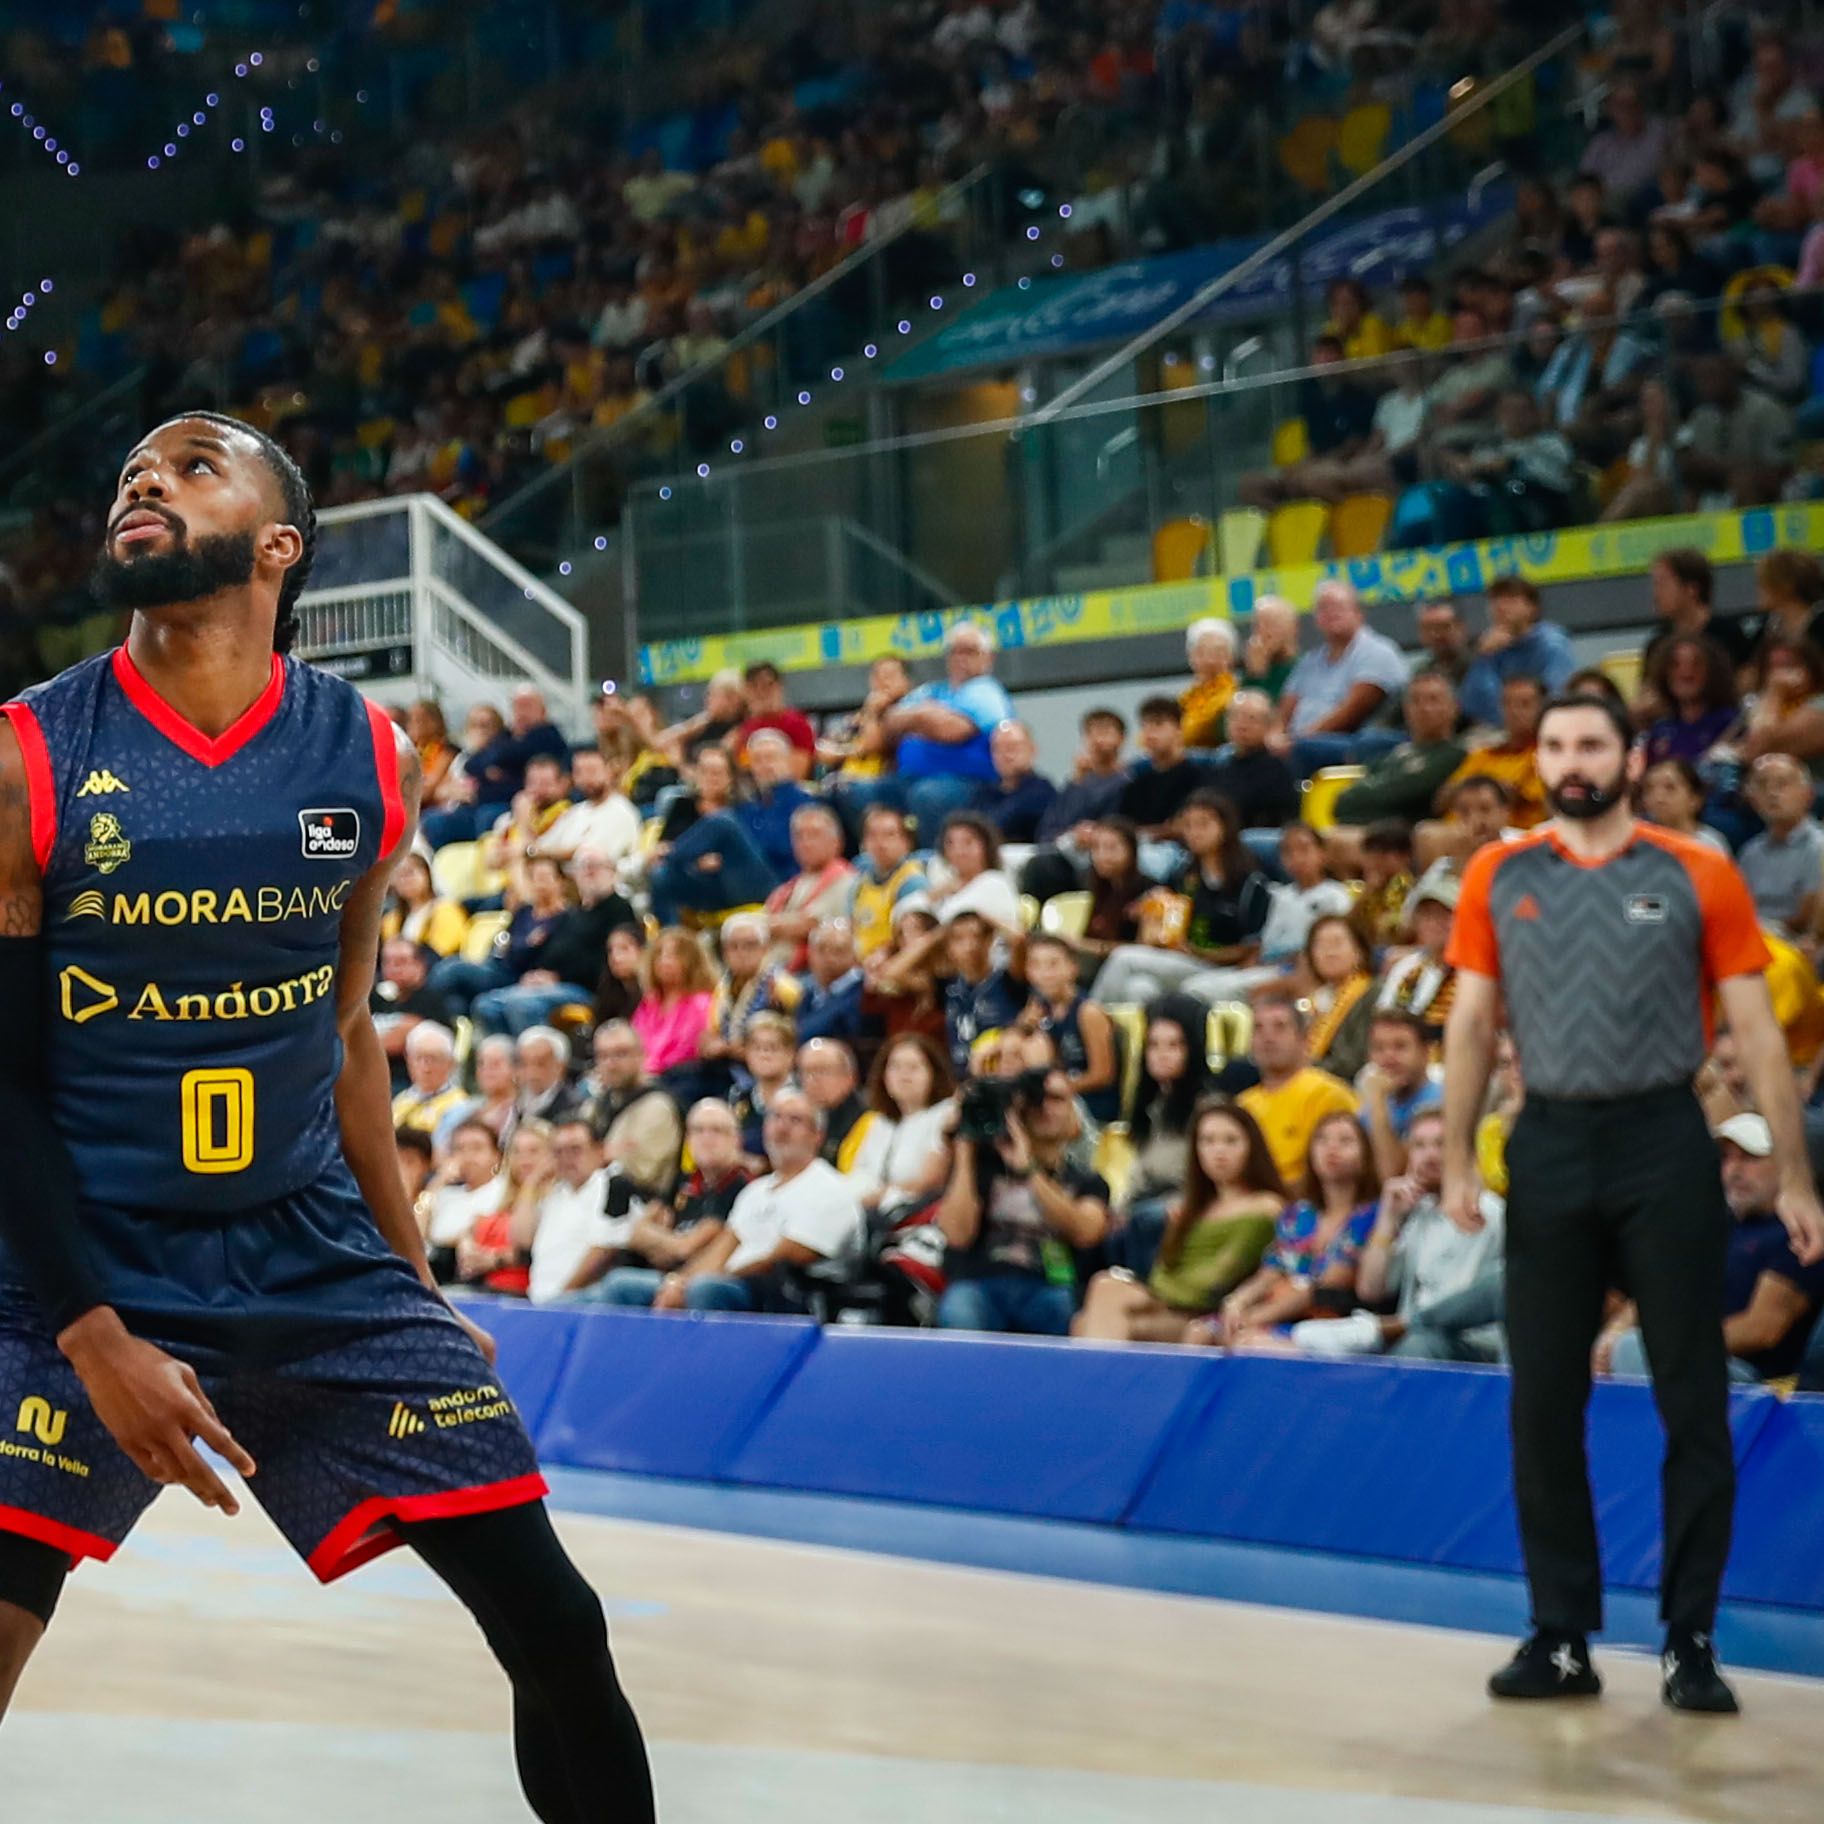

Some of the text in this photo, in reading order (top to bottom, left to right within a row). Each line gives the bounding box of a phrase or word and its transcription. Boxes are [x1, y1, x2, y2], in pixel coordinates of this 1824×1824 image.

[308, 823, 332, 841] liga
[112, 880, 350, 925] MORABANC
[127, 964, 334, 1022] Andorra
[181, 1067, 255, 1174] 0
[433, 1401, 511, 1429] telecom
[42, 1449, 56, 1467] la
[57, 1455, 90, 1477] Vella
